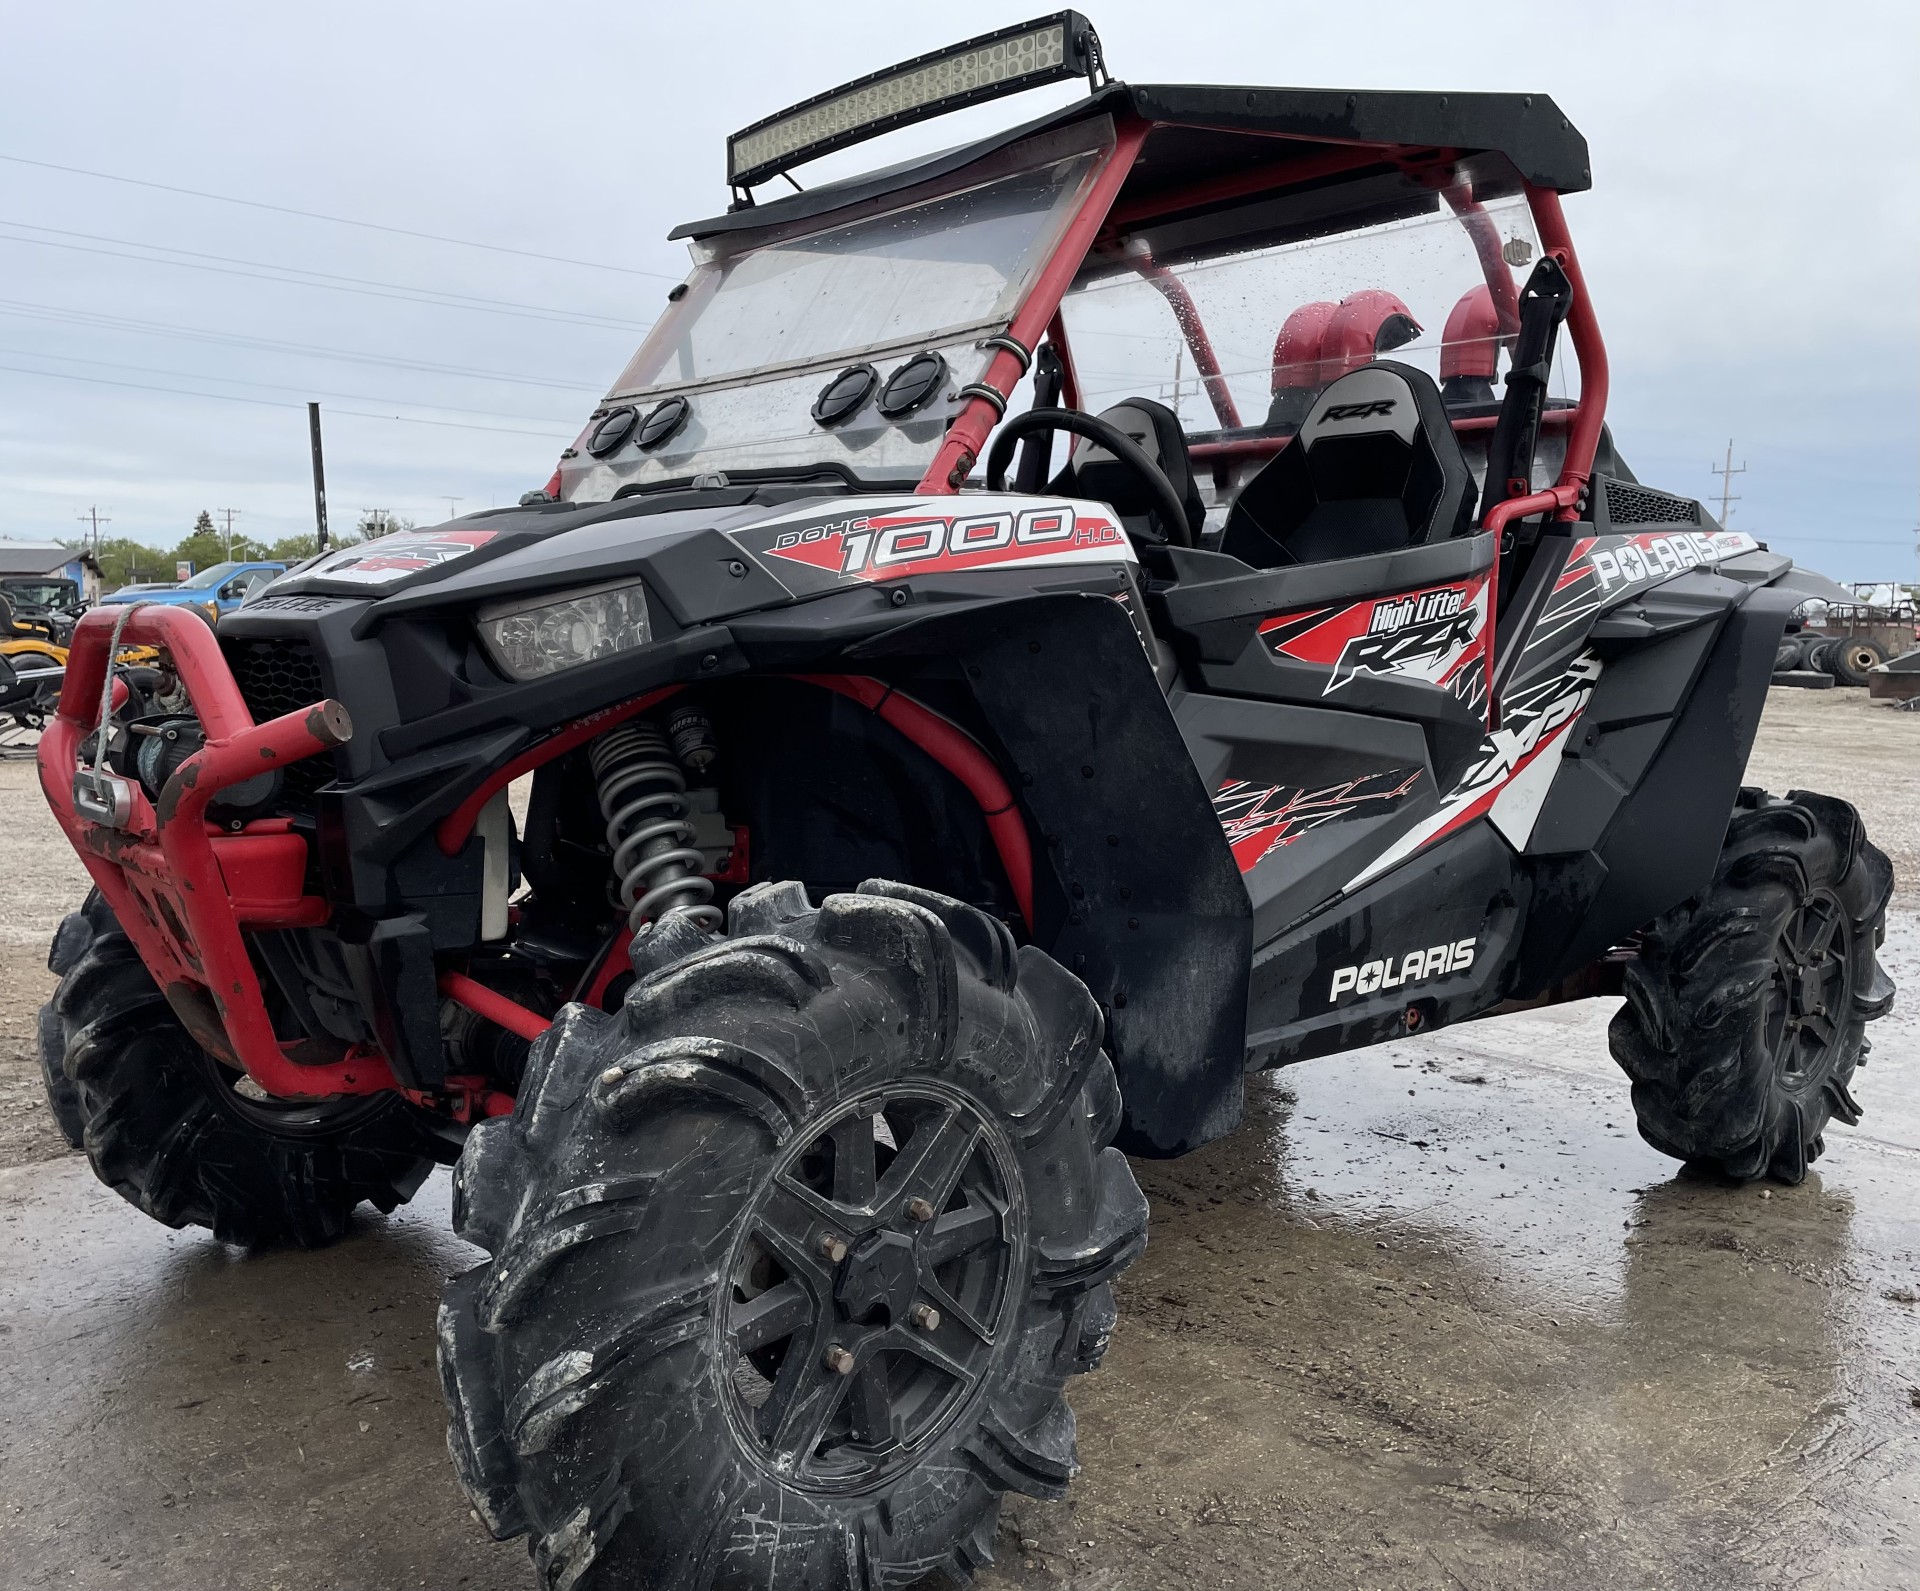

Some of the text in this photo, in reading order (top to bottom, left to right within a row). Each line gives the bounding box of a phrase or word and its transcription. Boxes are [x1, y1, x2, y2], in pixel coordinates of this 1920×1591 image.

[1317, 399, 1397, 425] RZR
[775, 516, 871, 550] DOHC
[838, 505, 1076, 578] 1000
[1590, 532, 1720, 593] POLARIS
[1370, 588, 1466, 633] High Lifter
[1321, 603, 1480, 698] RZR
[1329, 937, 1477, 1003] POLARIS
